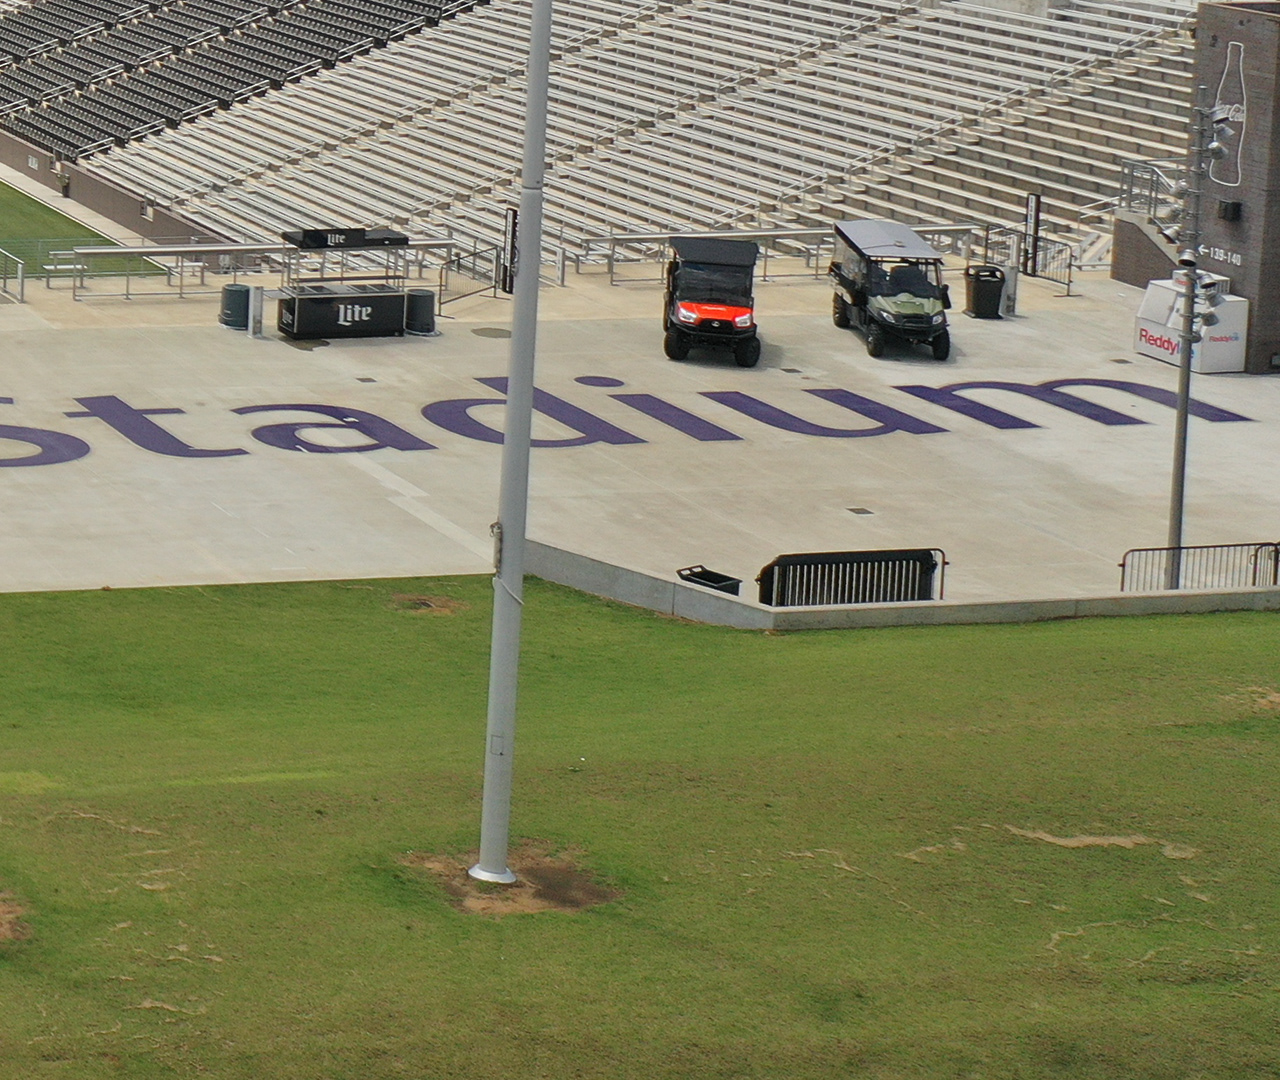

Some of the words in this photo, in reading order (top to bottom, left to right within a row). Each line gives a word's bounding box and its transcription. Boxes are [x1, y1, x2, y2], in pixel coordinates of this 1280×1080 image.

[327, 233, 346, 246] Lite
[1210, 247, 1242, 266] 139-140
[337, 304, 372, 326] Lite
